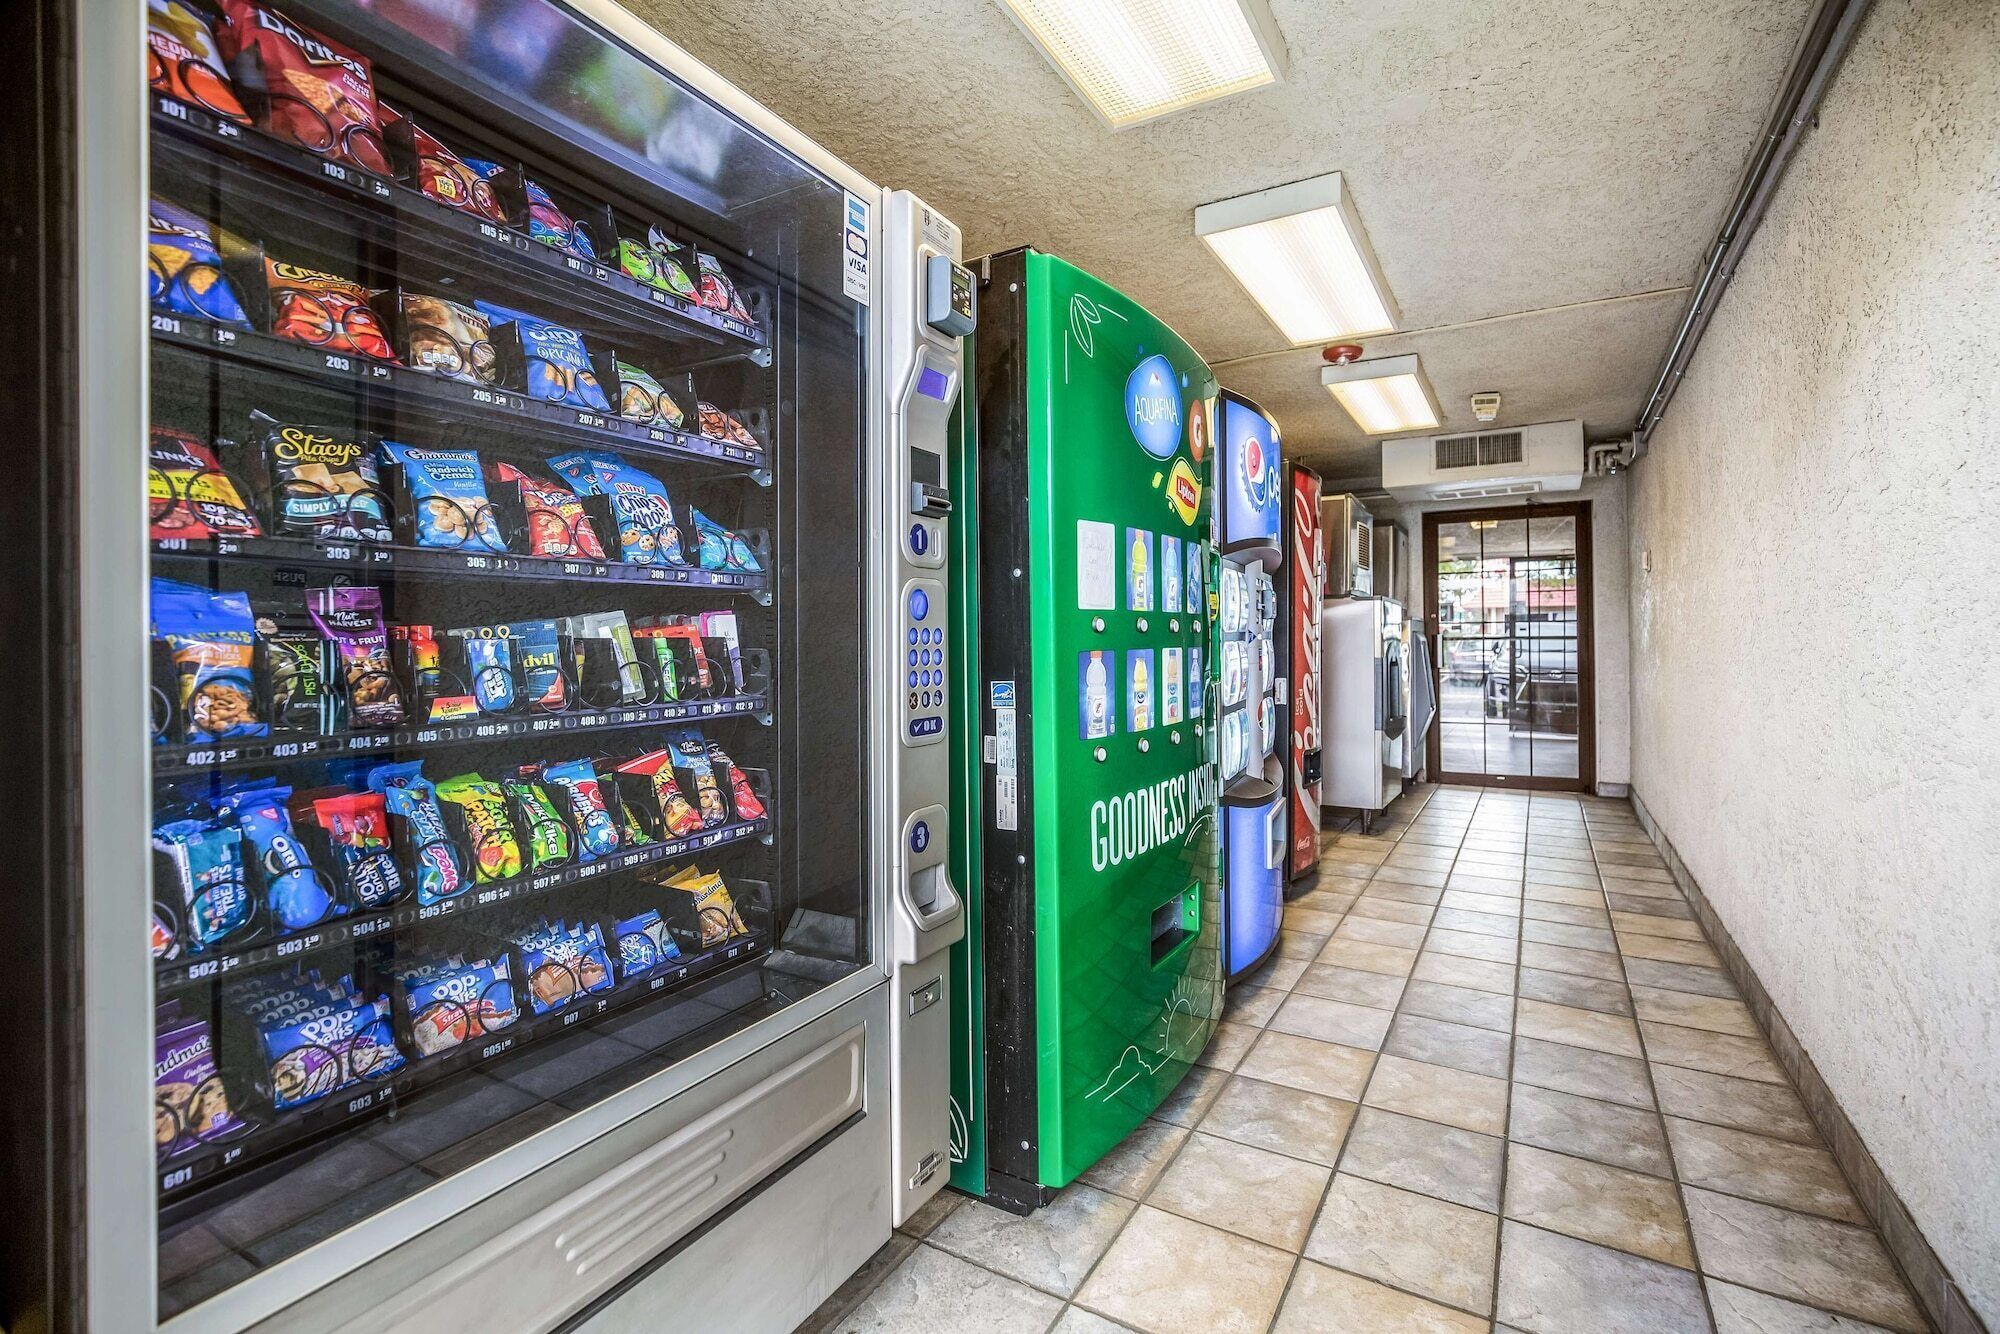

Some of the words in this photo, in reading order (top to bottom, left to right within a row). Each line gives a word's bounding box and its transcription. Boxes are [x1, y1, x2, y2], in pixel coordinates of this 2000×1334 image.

[257, 8, 369, 81] Doritos
[160, 98, 187, 120] 101
[323, 162, 346, 180] 103
[480, 223, 497, 239] 105
[567, 257, 581, 270] 107
[848, 257, 867, 275] VISA
[847, 276, 866, 290] DISCVER
[652, 290, 665, 303] 109
[152, 316, 181, 334] 201
[326, 355, 350, 371] 203
[473, 389, 492, 403] 205
[1134, 395, 1180, 426] AQUAFINA
[579, 413, 593, 425] 207
[650, 429, 664, 441] 209
[1193, 415, 1203, 448] G
[275, 428, 362, 466] Stacy's
[725, 447, 735, 457] 211
[424, 464, 475, 474] Sandwich
[430, 472, 475, 481] Cremes
[453, 480, 478, 488] Vanilla
[614, 482, 646, 496] Mini
[1177, 477, 1196, 507] Lipton
[292, 501, 330, 513] SIMPLY
[618, 494, 657, 513] Chips
[159, 537, 188, 550] 301
[916, 530, 922, 551] 1
[326, 546, 351, 560] 303
[467, 556, 486, 569] 305
[565, 563, 579, 574] 307
[651, 569, 664, 579] 309
[328, 619, 373, 629] HARVEST
[359, 635, 385, 646] FRUIT
[664, 707, 675, 717] 410
[702, 704, 712, 714] 411
[736, 702, 745, 710] 412
[533, 720, 548, 731] 407
[581, 715, 595, 726] 408
[923, 717, 937, 732] OK
[417, 729, 437, 743] 405
[477, 726, 494, 736] 406
[350, 736, 371, 749] 404
[273, 743, 298, 756] 403
[187, 751, 215, 765] 402
[1091, 774, 1186, 872] GOODNESS
[736, 828, 745, 837] 512
[917, 826, 926, 849] 3
[703, 836, 713, 846] 511
[666, 845, 677, 856] 510
[624, 855, 638, 866] 509
[376, 852, 401, 891] Bites
[580, 866, 595, 877] 508
[533, 878, 549, 890] 507
[479, 891, 497, 904] 506
[419, 905, 439, 919] 505
[353, 923, 375, 937] 504
[277, 942, 303, 956] 503
[728, 948, 738, 958] 611
[189, 961, 218, 979] 502
[651, 978, 664, 990] 609
[563, 1011, 578, 1025] 607
[483, 1045, 500, 1058] 605
[349, 1096, 372, 1112] 603
[163, 1166, 192, 1189] 601
